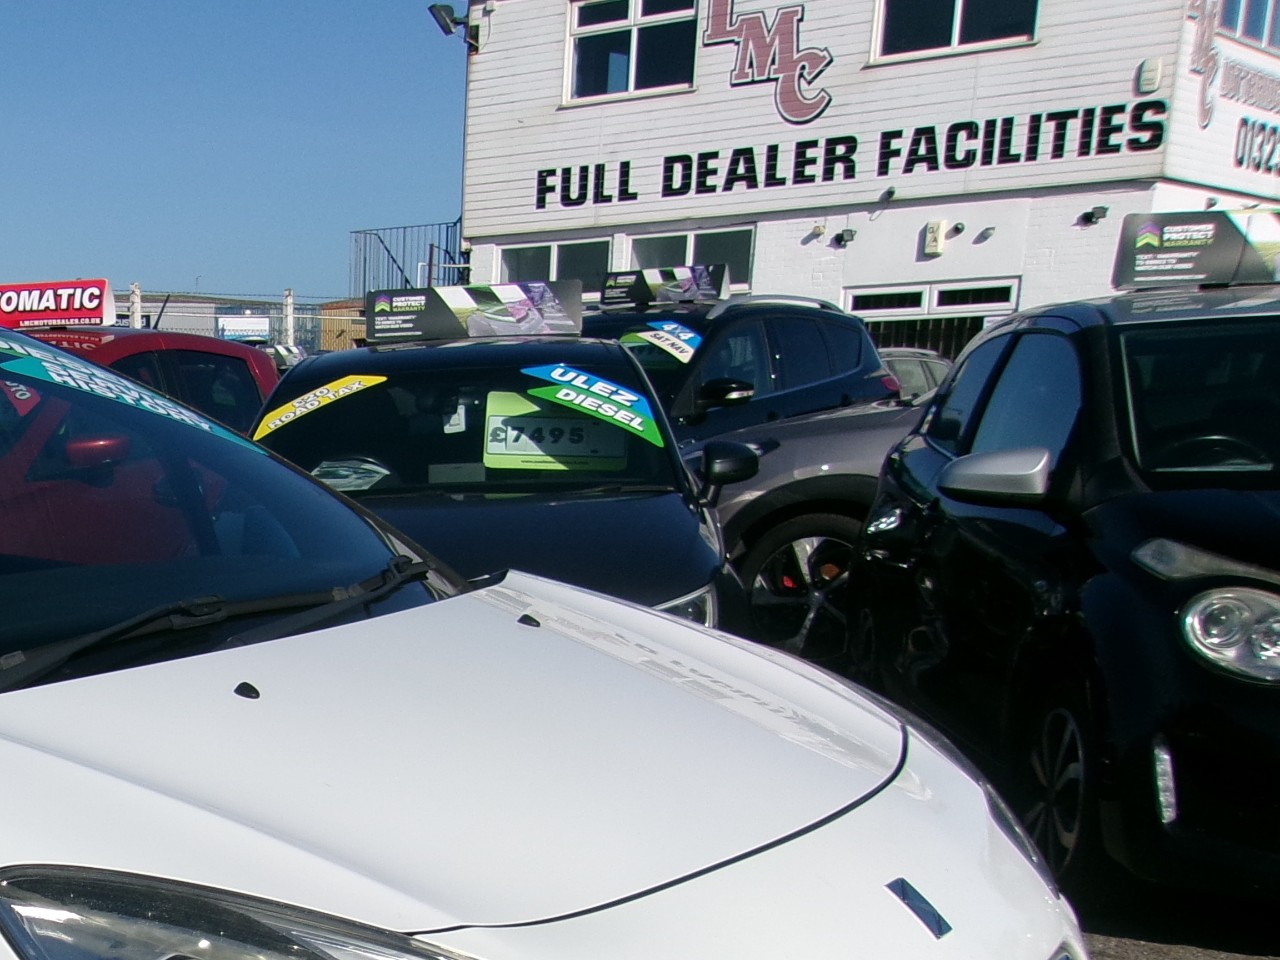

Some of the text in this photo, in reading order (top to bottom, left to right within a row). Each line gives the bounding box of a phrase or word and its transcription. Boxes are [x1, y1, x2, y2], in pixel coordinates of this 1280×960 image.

[703, 0, 834, 125] LMC
[536, 99, 1168, 209] FULL DEALER FACILITIES
[649, 333, 689, 355] SAT NAV
[267, 381, 367, 430] ROAD TAX
[550, 367, 640, 407] ULEZ
[555, 388, 645, 431] DIESEL
[488, 426, 585, 444] £7495
